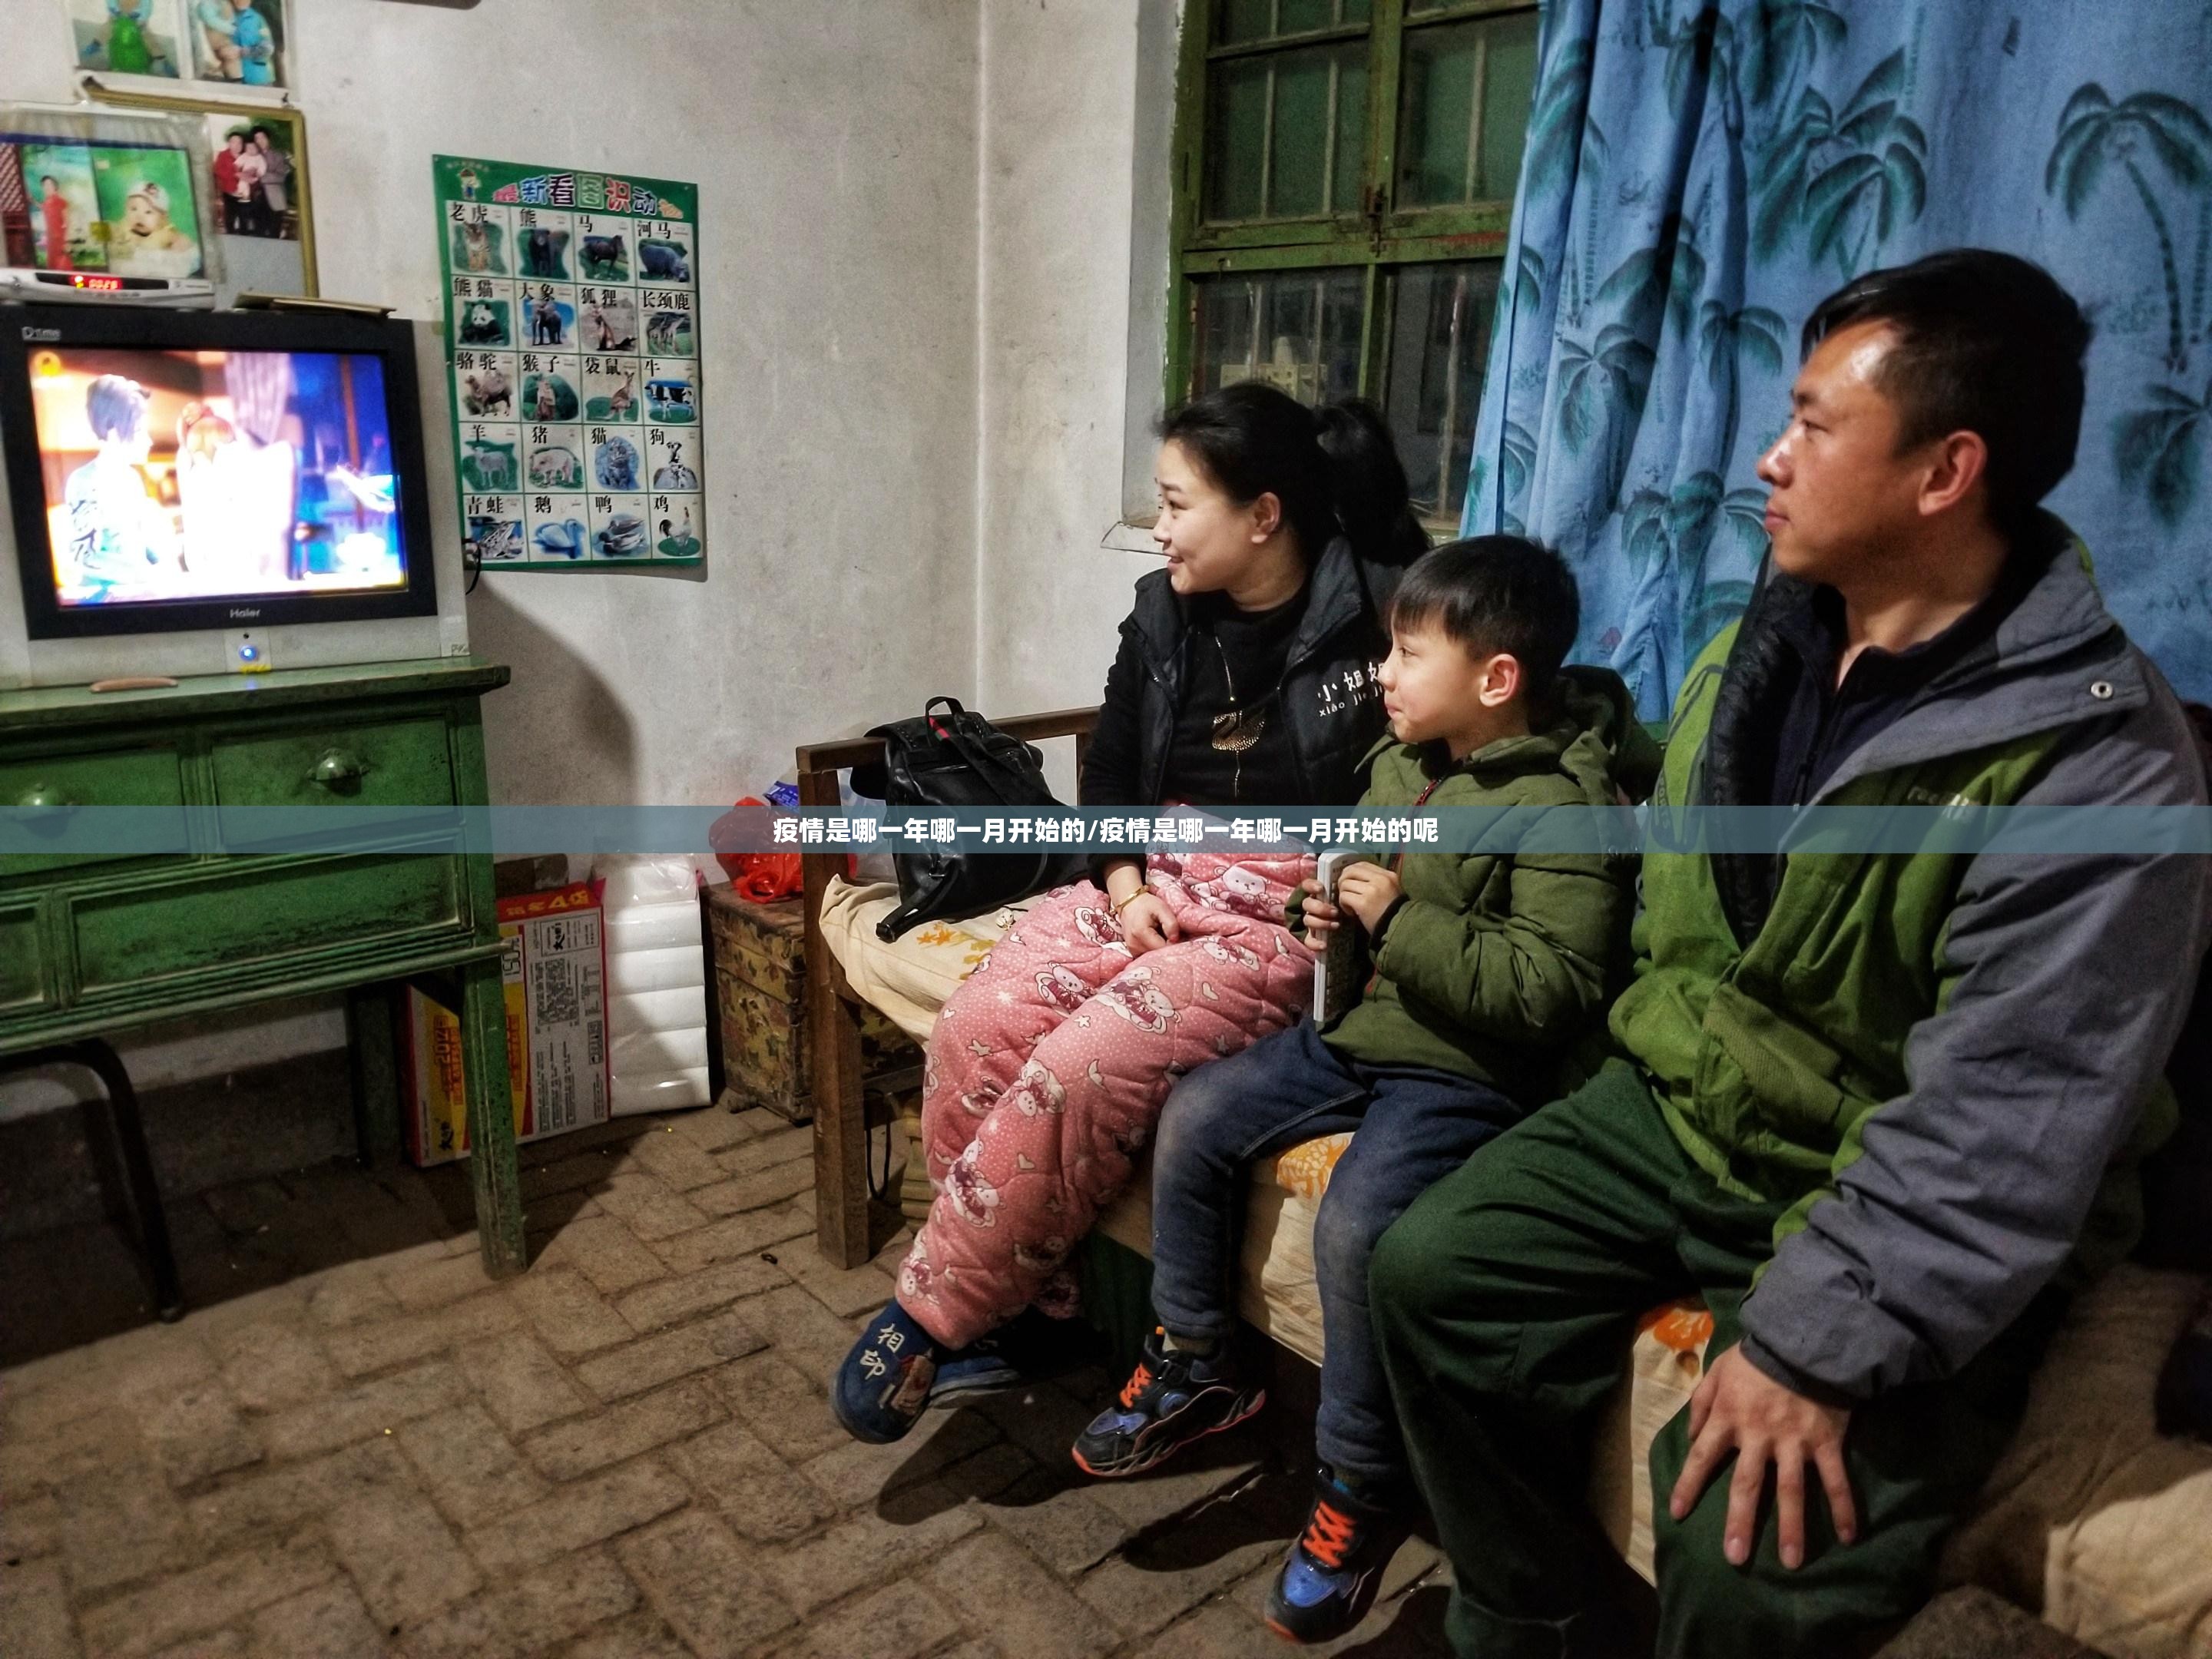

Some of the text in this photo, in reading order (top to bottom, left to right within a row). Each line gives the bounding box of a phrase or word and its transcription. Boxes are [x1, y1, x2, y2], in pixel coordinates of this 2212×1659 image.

[450, 203, 488, 223] 老虎
[520, 209, 537, 227] 熊
[577, 215, 592, 233] 马
[637, 220, 671, 239] 河马
[453, 277, 493, 298] 熊猫
[518, 282, 555, 302] 大象
[581, 287, 617, 309] 狐狸
[643, 290, 690, 310] 长颈鹿
[456, 352, 497, 370] 骆驼
[522, 354, 560, 373] 猴子
[585, 357, 621, 375] 袋鼠
[644, 359, 661, 376] 牛
[469, 424, 485, 442] 羊
[532, 426, 548, 444] 猪
[591, 427, 607, 445] 猫
[650, 429, 664, 445] 狗
[469, 495, 504, 515] 青蛙
[535, 495, 551, 513] 鹅
[595, 495, 612, 513] 鸭
[654, 495, 669, 512] 鸡
